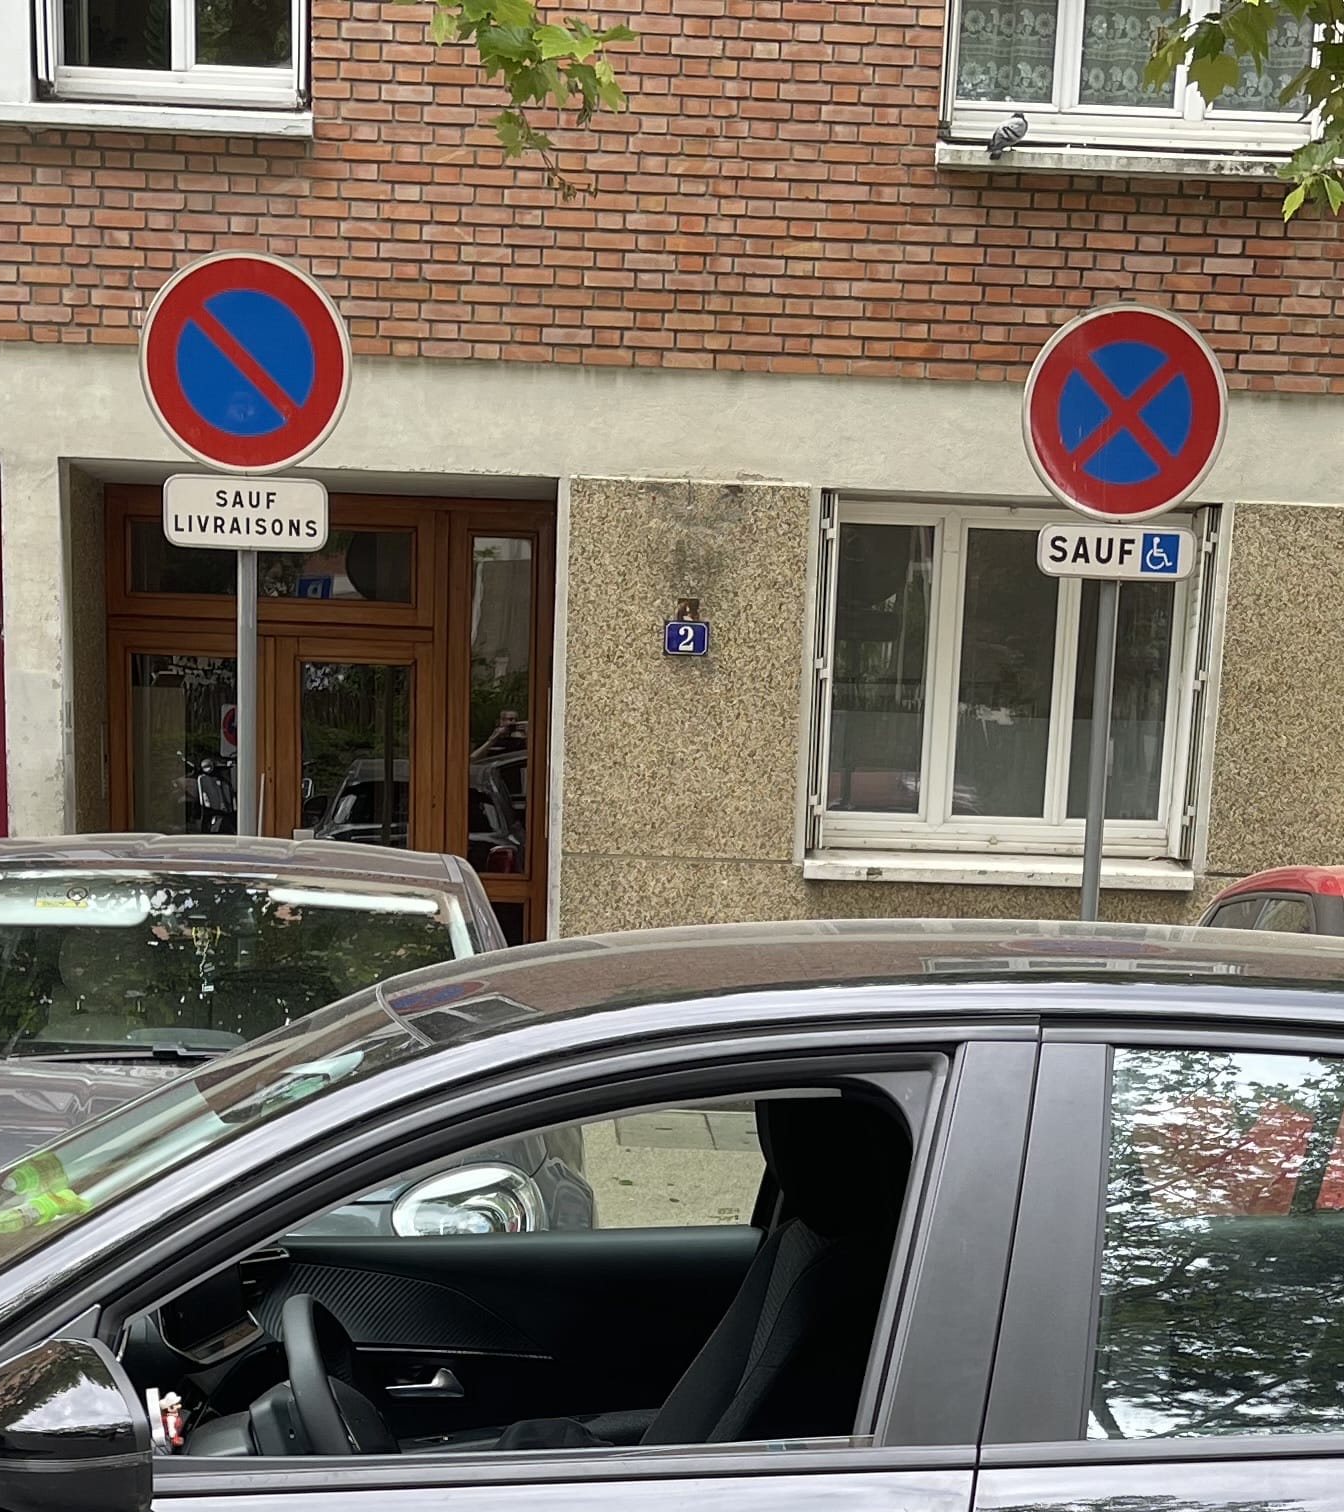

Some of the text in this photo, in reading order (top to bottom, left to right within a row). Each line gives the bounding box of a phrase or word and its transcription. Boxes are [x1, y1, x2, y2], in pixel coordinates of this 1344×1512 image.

[215, 489, 277, 509] SAUF
[174, 514, 318, 538] LIVRAISONS
[1049, 535, 1136, 565] SAUF
[678, 625, 694, 651] 2
